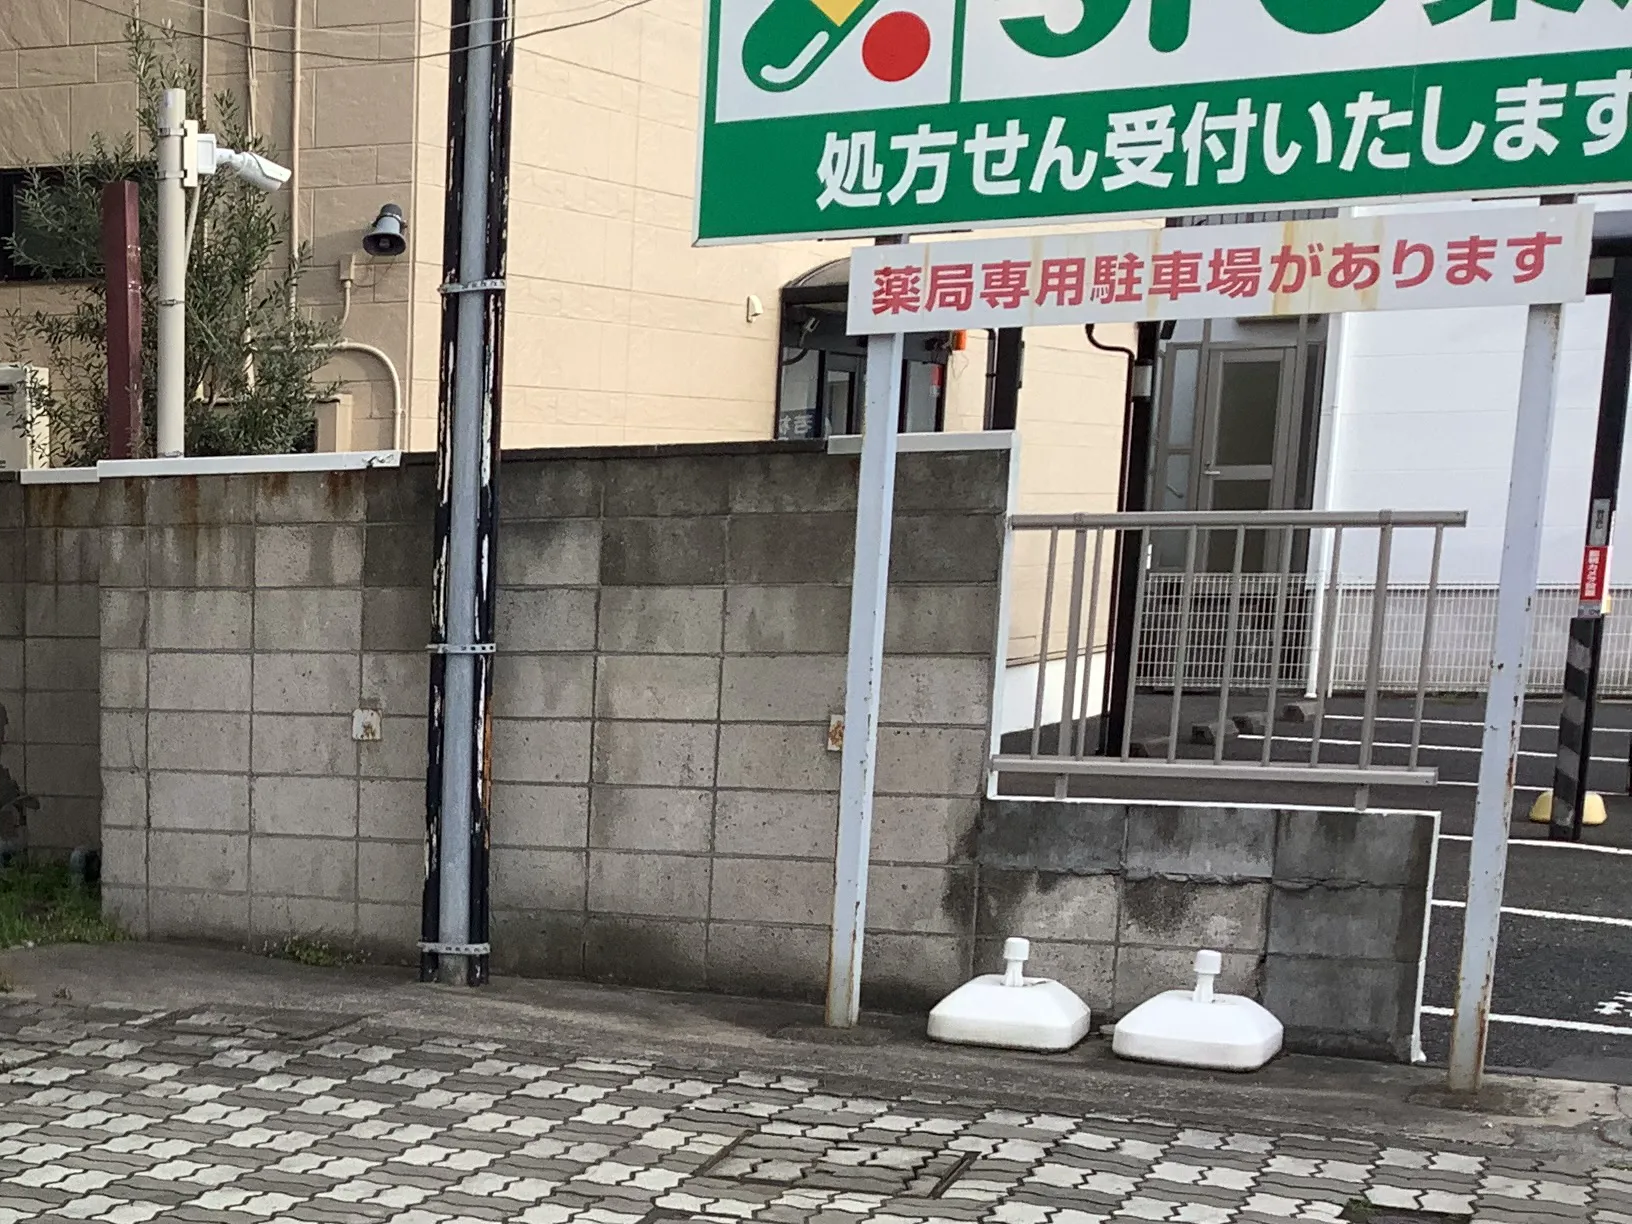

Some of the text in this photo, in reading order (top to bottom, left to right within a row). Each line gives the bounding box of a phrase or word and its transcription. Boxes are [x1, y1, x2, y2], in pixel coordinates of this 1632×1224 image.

[816, 66, 1632, 211] 処方せん受付いたします
[870, 230, 1564, 317] 薬局専用駐車場があります
